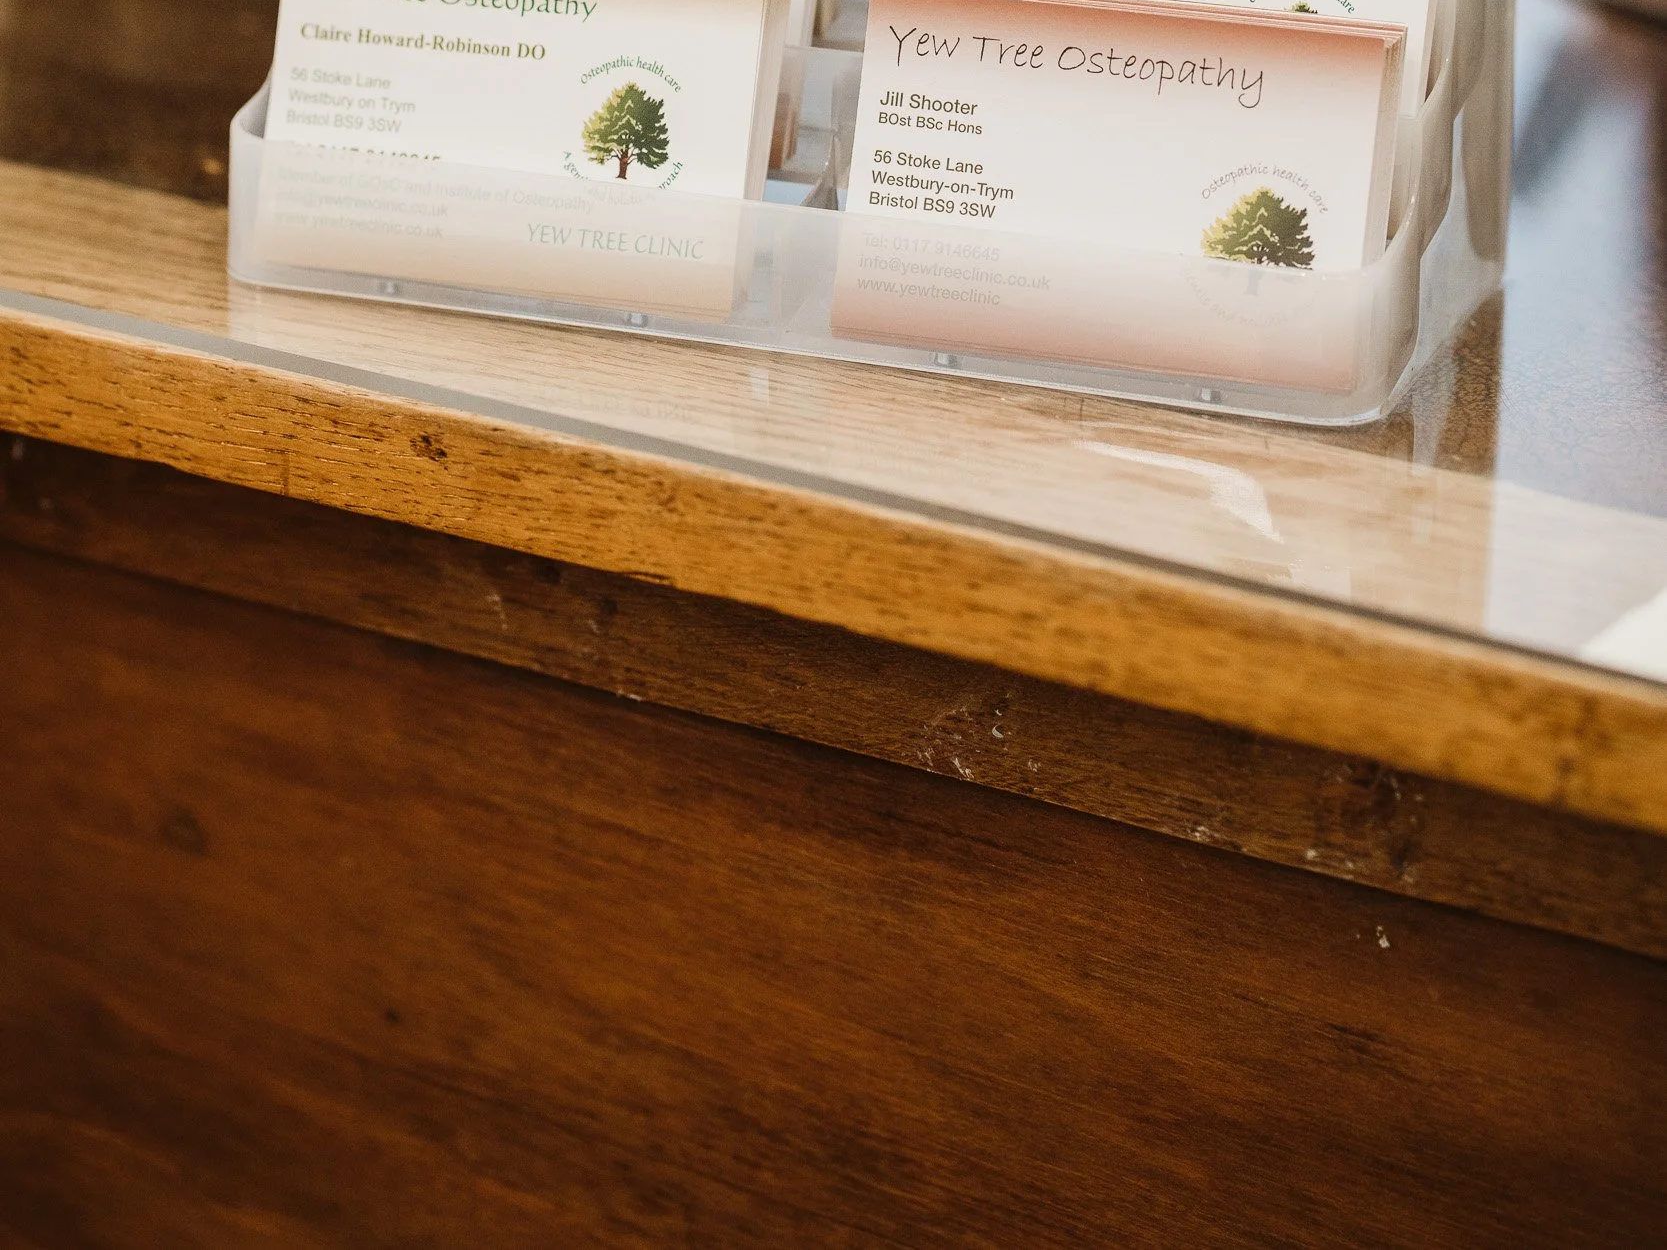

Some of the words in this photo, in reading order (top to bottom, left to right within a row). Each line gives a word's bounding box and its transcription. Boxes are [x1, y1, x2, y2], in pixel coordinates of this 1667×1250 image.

[300, 22, 352, 43] Claire
[357, 29, 511, 58] Howard-Robinson
[516, 43, 546, 60] DO
[290, 66, 308, 81] 56
[312, 68, 353, 86] Stoke
[356, 72, 391, 90] Lane
[580, 55, 635, 85] Osteopathic
[635, 56, 665, 78] health
[664, 74, 682, 93] care
[889, 25, 960, 67] Yew
[972, 35, 1044, 69] Tree
[1058, 46, 1263, 109] Osteopathy
[288, 87, 353, 110] Westbury
[358, 97, 376, 109] on
[381, 97, 416, 115] Trym
[880, 90, 904, 108] Jill
[909, 94, 978, 116] Shooter
[287, 110, 330, 127] Bristol
[333, 114, 364, 130] BS9
[367, 117, 403, 134] 3SW
[878, 112, 912, 127] BOst
[916, 116, 943, 131] BSc
[947, 120, 983, 135] Hons
[873, 149, 892, 165] 56
[896, 152, 940, 170] Stoke
[945, 158, 983, 175] Lane
[871, 170, 1014, 201] Westbury-on-Trym
[1202, 163, 1268, 200] Osteopathic
[1272, 164, 1309, 190] health
[1308, 190, 1329, 214] care
[869, 190, 918, 210] Bristol
[923, 197, 954, 214] BS9
[959, 202, 996, 219] 3SW
[527, 223, 572, 246] YEW
[577, 228, 629, 252] TREE
[634, 234, 704, 260] CLINIC
[892, 236, 931, 252] 0117
[859, 252, 1051, 290] info@yewtreeclinic.co.uk
[857, 277, 1001, 306] www.yewtreeclinic
